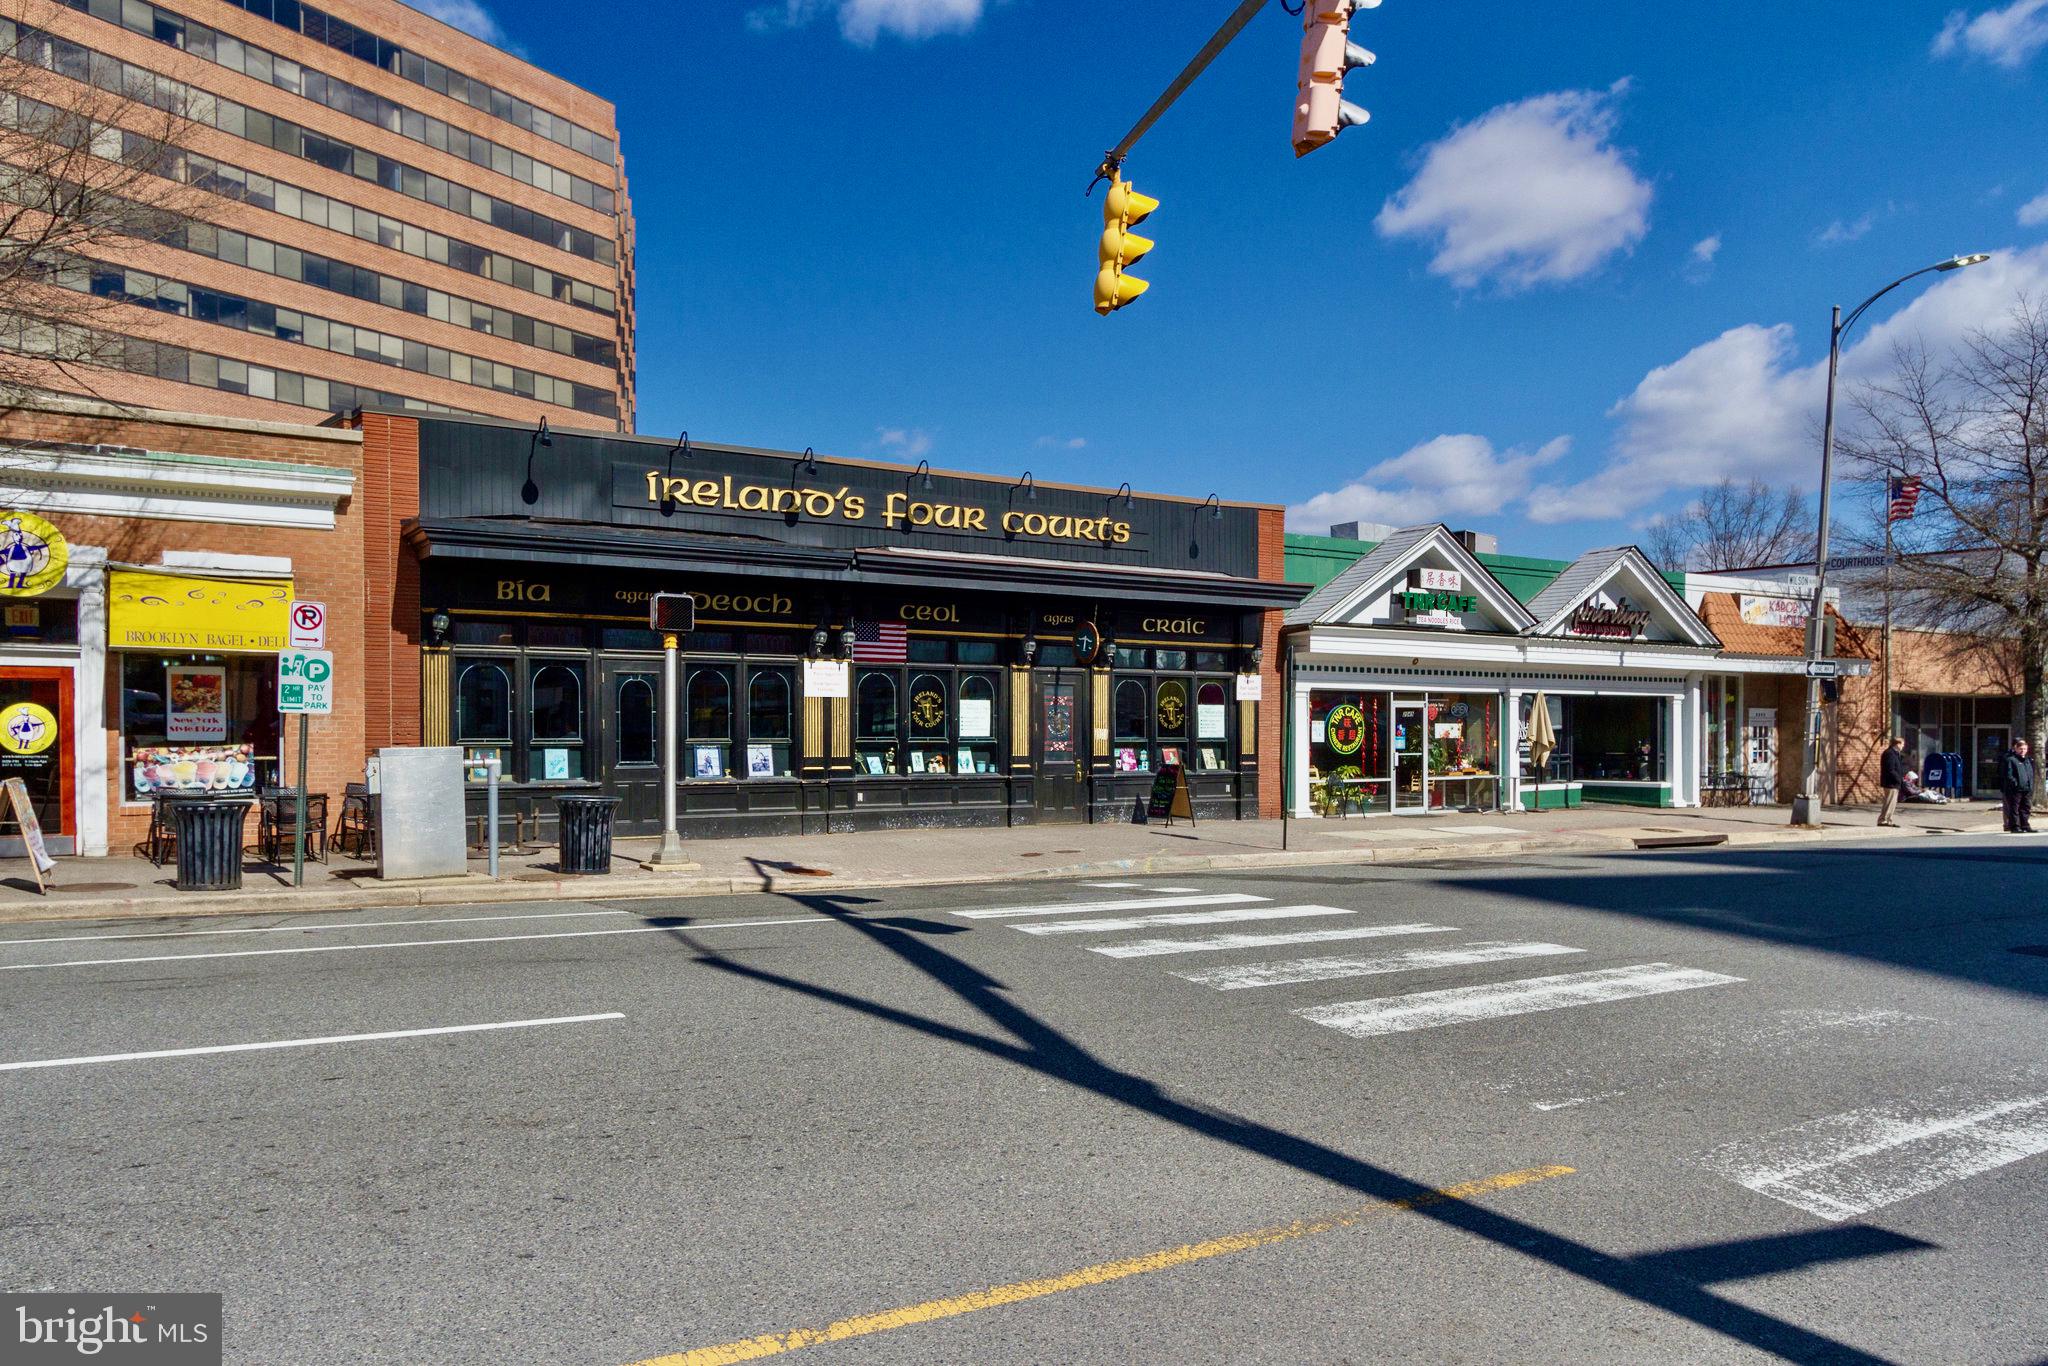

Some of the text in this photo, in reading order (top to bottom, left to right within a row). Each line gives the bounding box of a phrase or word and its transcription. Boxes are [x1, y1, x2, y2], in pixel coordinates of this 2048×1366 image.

[1831, 556, 1886, 568] COURTHOUSE
[1790, 576, 1809, 585] WILSON
[615, 590, 653, 604] agu
[1402, 592, 1477, 613] TNR CAFE
[1769, 601, 1799, 614] KABOB
[11, 608, 33, 624] EXIT
[125, 630, 286, 648] BROOKLYN BAGEL DELI
[284, 685, 290, 694] 2
[311, 693, 322, 701] TO
[913, 691, 942, 703] IRELAND'S
[304, 701, 328, 709] PARK
[1332, 707, 1361, 725] TNR CAFE
